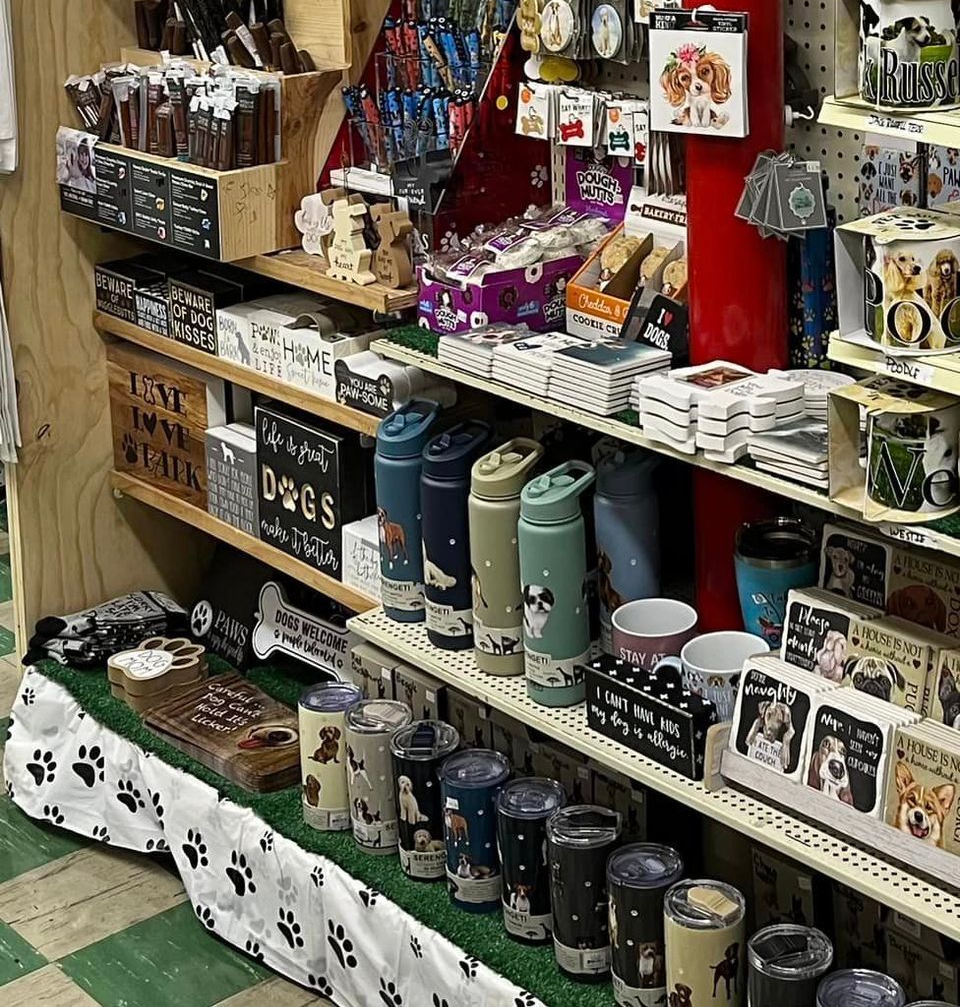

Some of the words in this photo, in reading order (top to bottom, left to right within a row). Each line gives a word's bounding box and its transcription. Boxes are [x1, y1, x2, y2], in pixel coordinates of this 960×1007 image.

[580, 184, 614, 205] MUTTS
[96, 273, 133, 299] BEWARE
[172, 286, 212, 314] BEWARE
[173, 304, 187, 319] OF
[190, 310, 213, 331] DOG
[573, 313, 605, 330] COOKIE
[174, 321, 215, 351] KISSES
[885, 357, 921, 380] POODLE
[341, 383, 388, 411] PAW-SOME
[350, 377, 364, 390] YOU
[364, 383, 377, 393] ARE
[262, 418, 284, 447] life
[287, 439, 297, 456] is
[298, 443, 335, 473] great
[138, 443, 200, 490] BARK
[261, 517, 289, 543] make
[291, 527, 302, 555] it
[303, 530, 339, 571] better
[214, 611, 249, 646] PAWS
[275, 609, 300, 630] DOGS
[302, 614, 349, 652] WELCOME
[619, 648, 646, 665] STAY
[204, 693, 225, 708] Dog
[208, 683, 251, 704] Careful
[744, 683, 797, 706] naughty
[192, 714, 238, 734] Licker!
[197, 704, 226, 721] Hold
[229, 711, 249, 727] It's
[591, 704, 607, 725] my
[610, 712, 629, 735] dog
[633, 722, 644, 738] is
[596, 686, 600, 699] I
[633, 706, 655, 727] HAVE
[660, 717, 681, 739] KIDS
[755, 751, 776, 765] COUCH
[906, 740, 937, 761] HOUSE
[938, 753, 947, 764] IS
